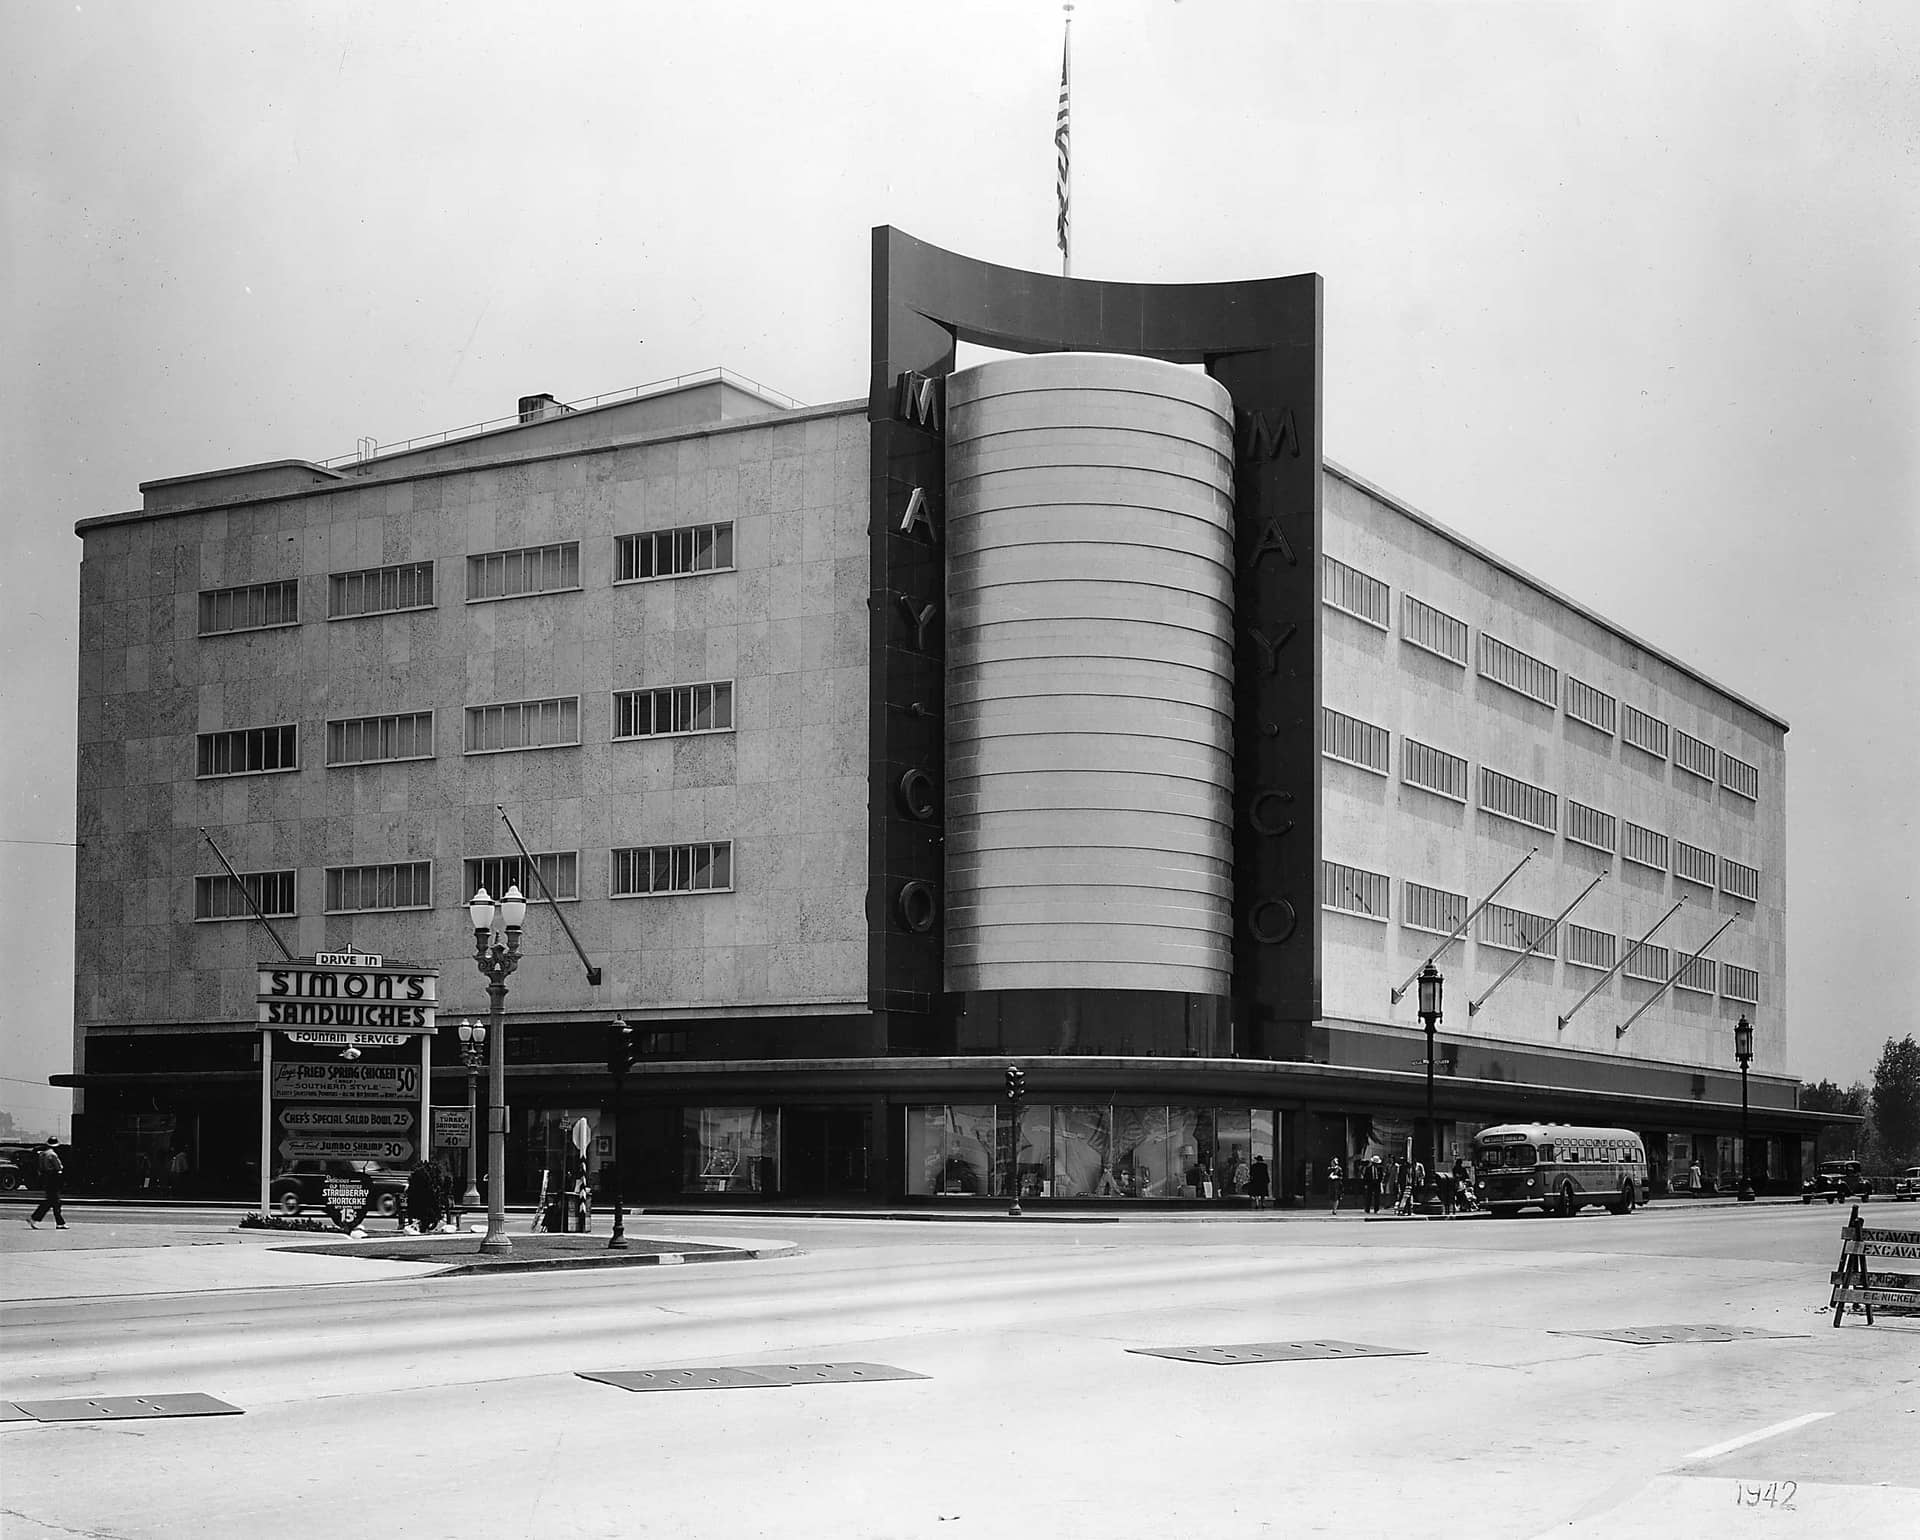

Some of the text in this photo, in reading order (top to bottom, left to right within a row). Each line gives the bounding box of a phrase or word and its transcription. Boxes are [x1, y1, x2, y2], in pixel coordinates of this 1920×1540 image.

[321, 955, 378, 966] DRIVE IN
[271, 972, 425, 1000] SIMON'S
[268, 1002, 425, 1027] SANDWICHES
[296, 1032, 400, 1044] FOUNTAIN SERVICE
[297, 1064, 326, 1080] FRIED
[327, 1065, 360, 1080] SPRING
[361, 1066, 396, 1080] CHICKEN
[284, 1112, 310, 1124] CHEF'S
[312, 1113, 343, 1125] SPECIAL
[345, 1113, 369, 1125] SALAD
[371, 1114, 392, 1125] BOWL
[320, 1141, 351, 1151] JUMBO
[352, 1142, 383, 1152] SHRIMP
[321, 1188, 369, 1197] STRAWBERRY
[326, 1197, 367, 1205] SHORTCAKE
